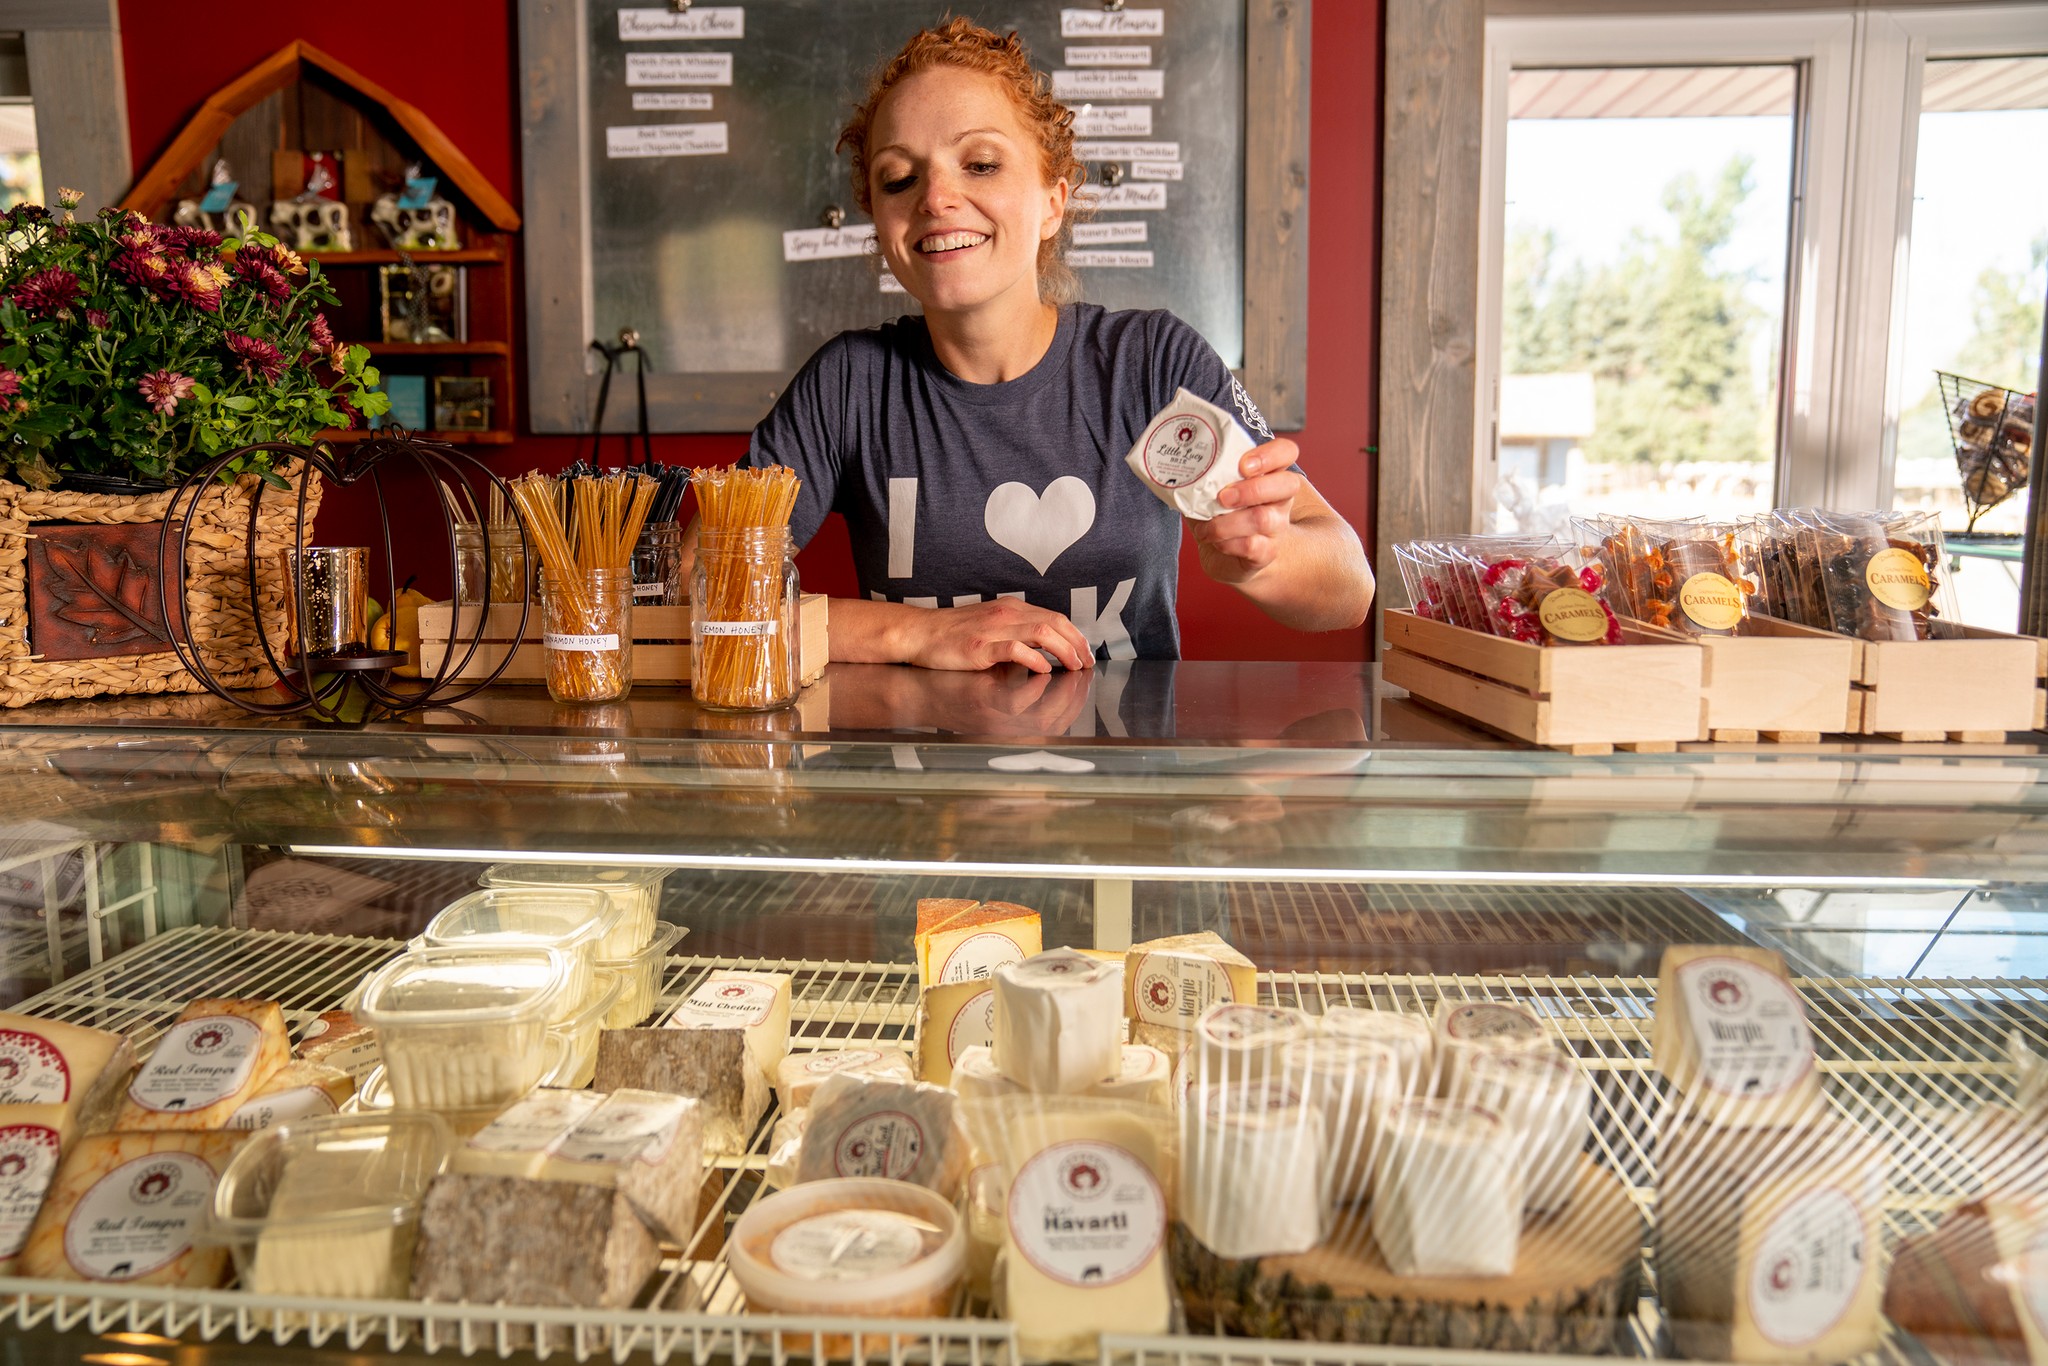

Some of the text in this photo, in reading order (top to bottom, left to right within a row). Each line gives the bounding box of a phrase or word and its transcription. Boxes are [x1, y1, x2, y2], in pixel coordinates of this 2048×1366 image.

[1157, 444, 1204, 462] Little Lucy
[888, 477, 918, 578] I
[1870, 572, 1927, 587] CARAMELS
[1683, 594, 1740, 609] CARAMELS
[1544, 608, 1604, 624] CARAMELS
[701, 624, 764, 634] LEMON HONEY
[579, 637, 607, 648] HONEY
[687, 998, 713, 1008] Mild
[716, 1002, 762, 1012] Cheddar
[1178, 978, 1198, 1018] Margie
[150, 1063, 236, 1077] Red Temper
[1044, 1211, 1129, 1231] Havarti
